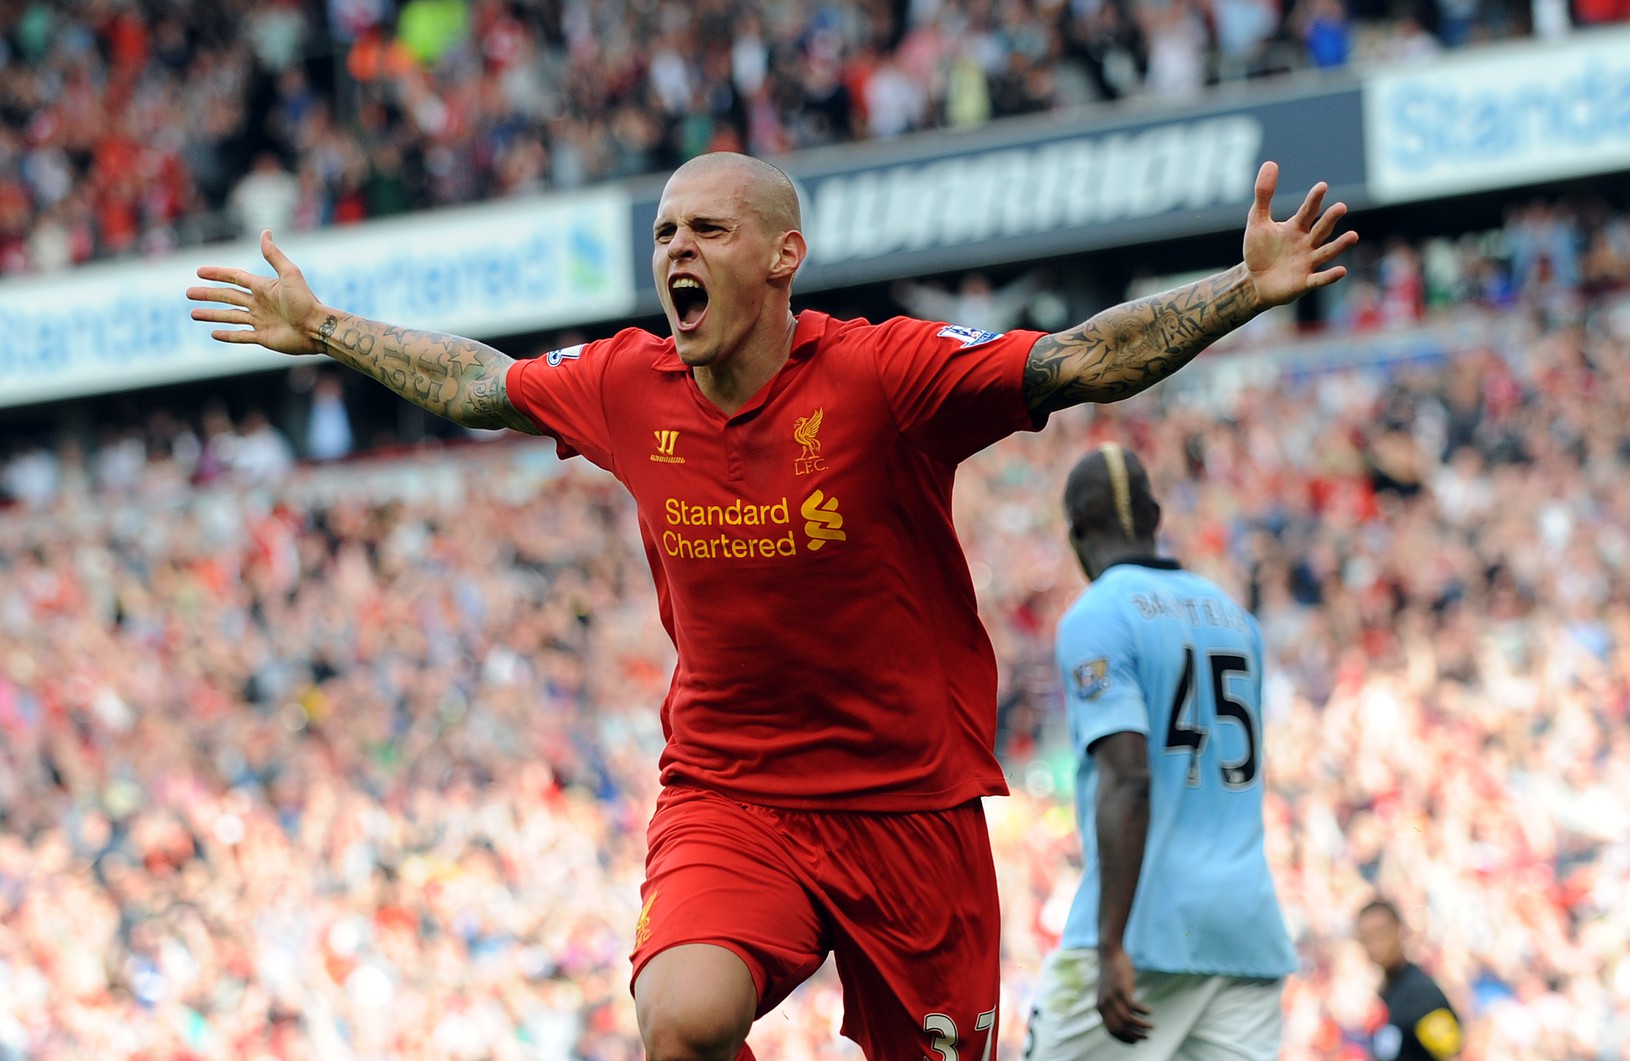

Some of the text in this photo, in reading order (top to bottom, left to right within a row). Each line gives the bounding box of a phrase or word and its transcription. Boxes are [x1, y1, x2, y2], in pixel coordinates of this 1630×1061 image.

[808, 113, 1265, 265] WARRIOR
[665, 497, 790, 526] Standard
[662, 530, 797, 558] Chartered
[1164, 642, 1260, 793] 45
[923, 1004, 997, 1061] 37
